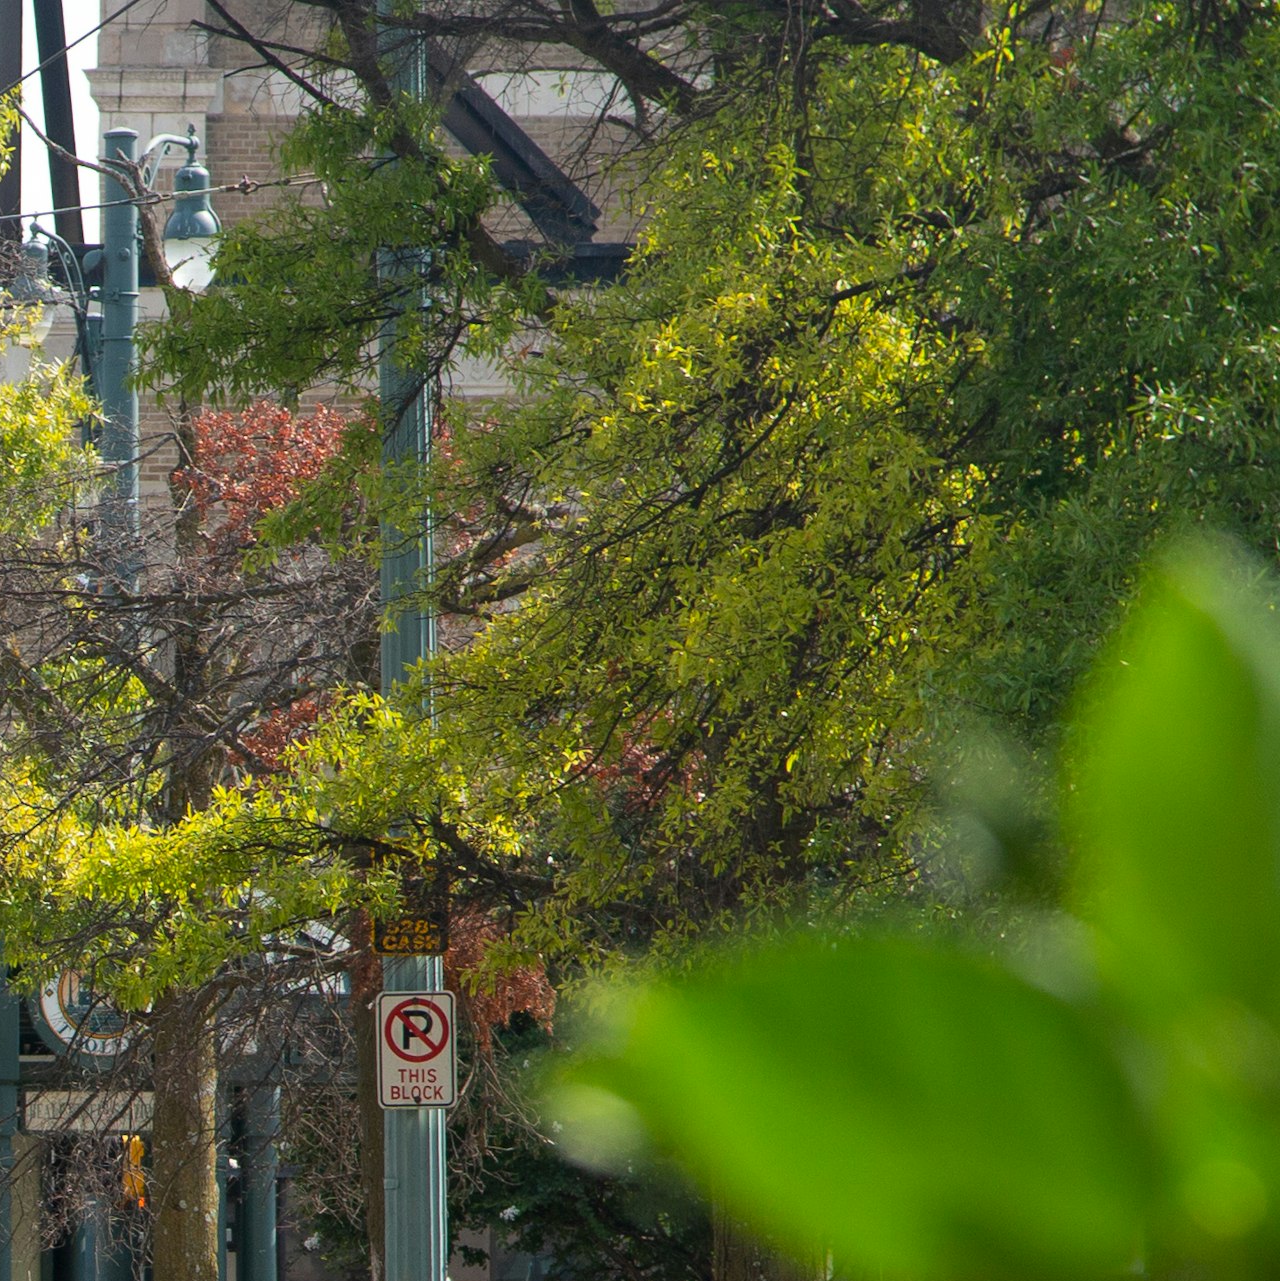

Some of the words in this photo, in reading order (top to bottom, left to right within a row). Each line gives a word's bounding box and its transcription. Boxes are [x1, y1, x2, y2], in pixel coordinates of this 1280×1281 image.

[382, 935, 440, 950] CASH
[398, 1069, 437, 1083] THIS
[390, 1085, 444, 1101] BLOCK
